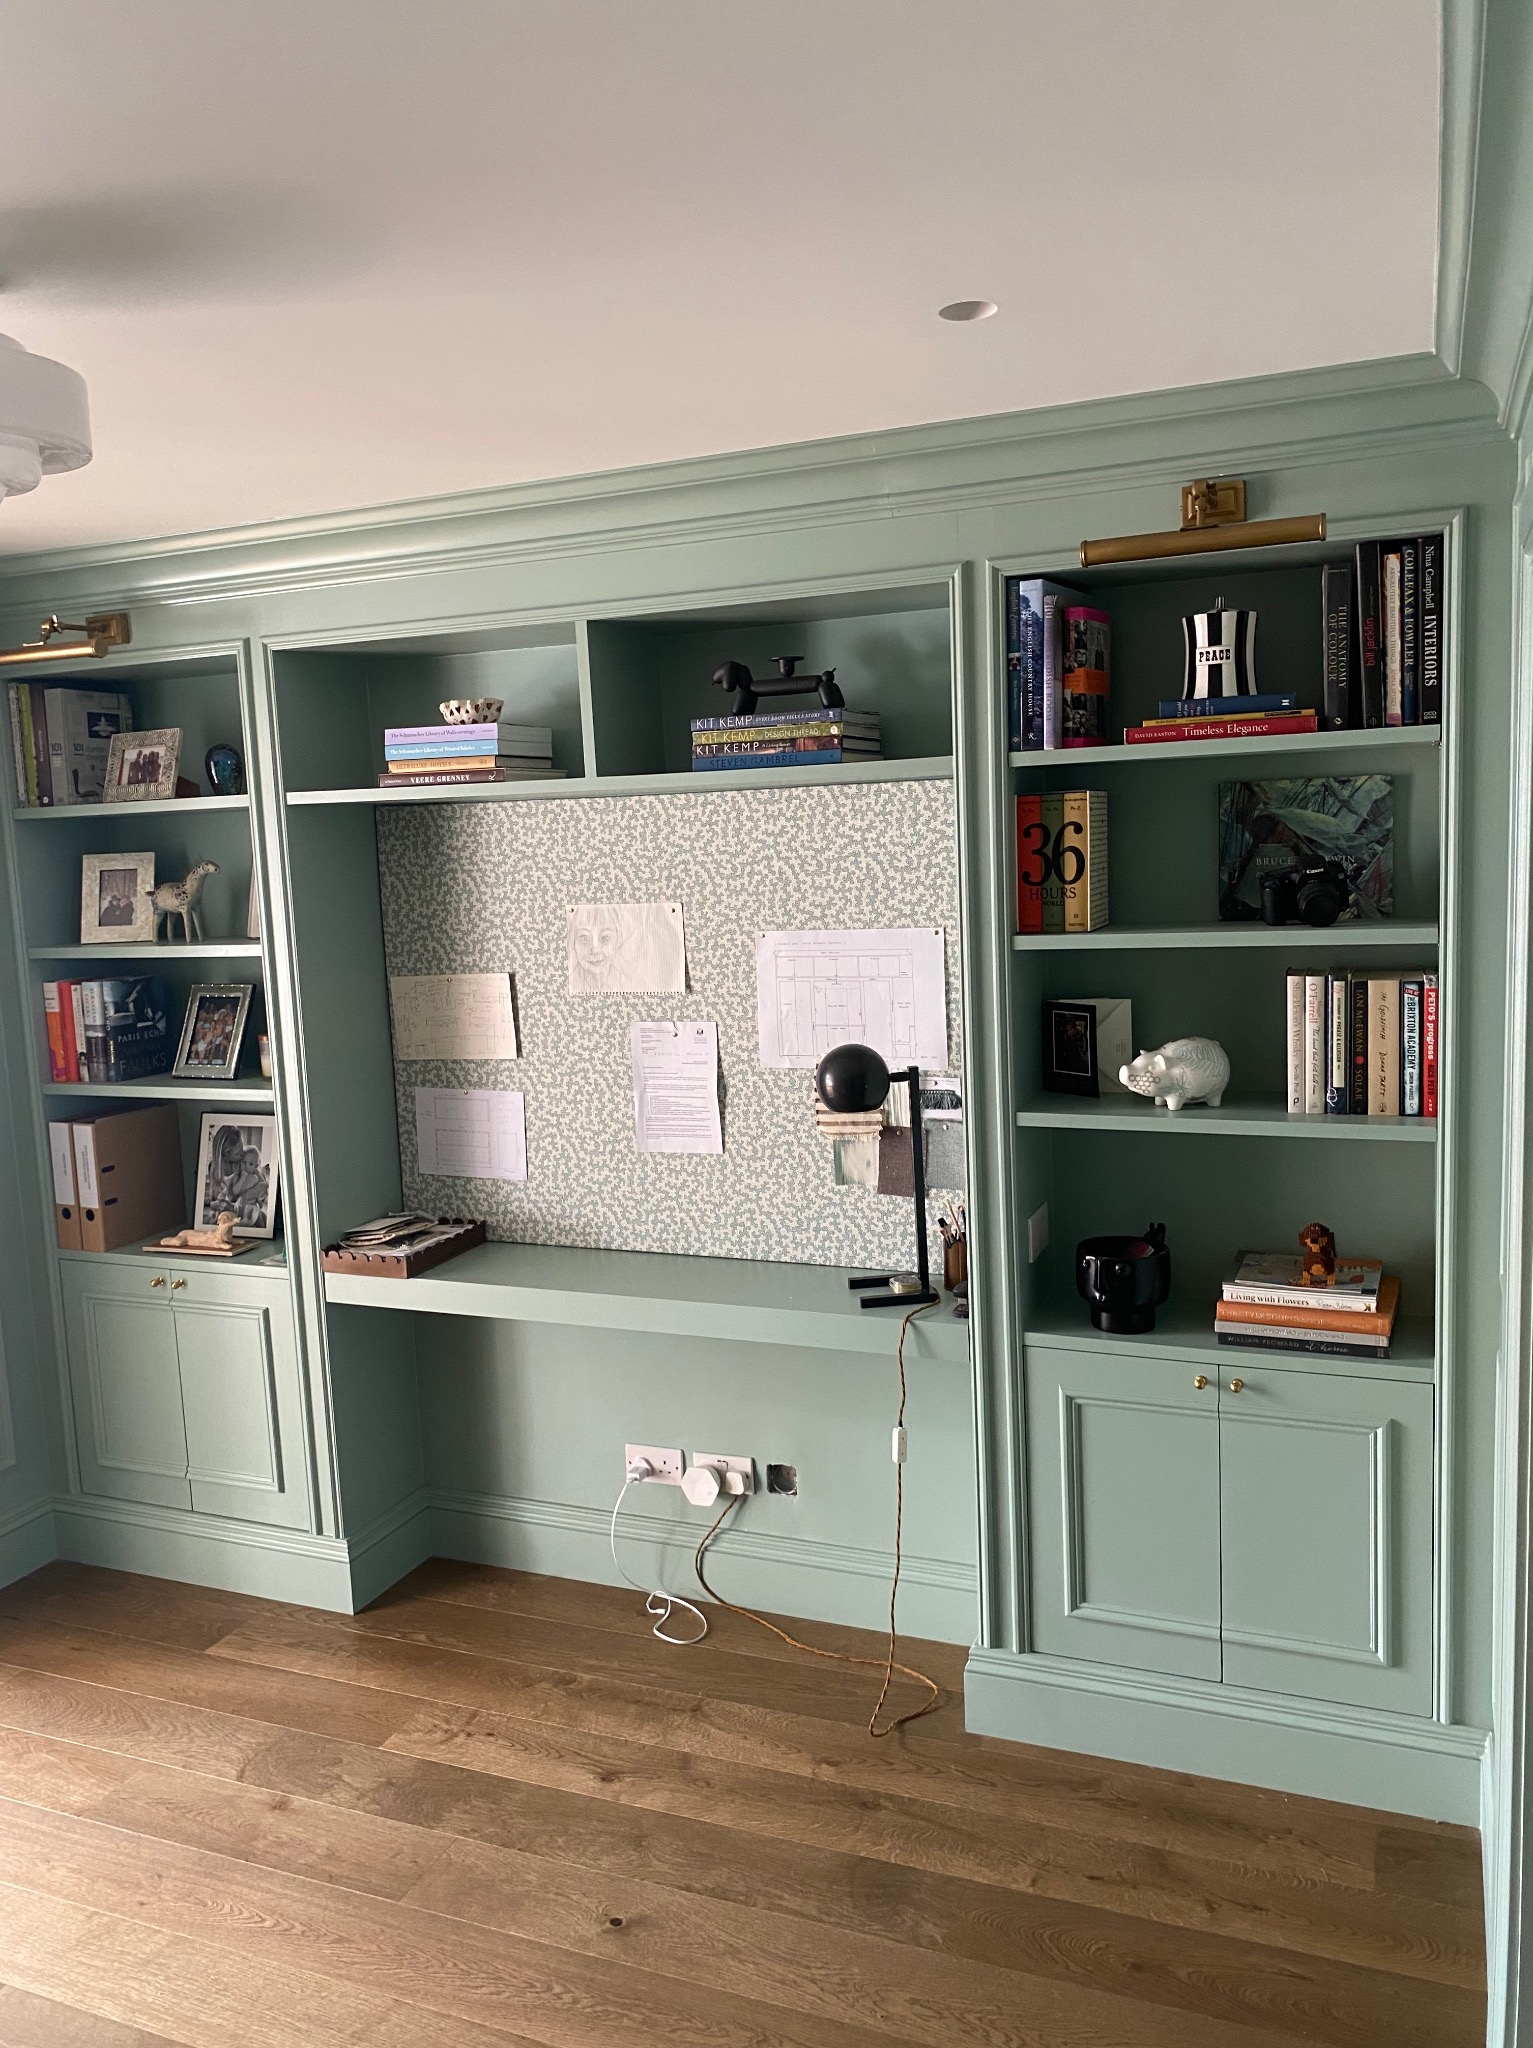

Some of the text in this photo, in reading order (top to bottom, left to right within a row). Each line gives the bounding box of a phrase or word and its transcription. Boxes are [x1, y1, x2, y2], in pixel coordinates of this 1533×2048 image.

[1404, 549, 1414, 609] COLEFAX
[1404, 607, 1413, 615] &
[1423, 546, 1437, 687] Nina Campbell INTERIORS
[1328, 613, 1338, 681] OF COLOUR
[1338, 605, 1348, 688] THE ANATOMY
[1364, 617, 1378, 667] bill jacklin
[1404, 618, 1414, 667] FOWLER
[1198, 648, 1231, 663] PEACE
[696, 717, 715, 729] KIT
[719, 715, 753, 728] KEMP
[1134, 723, 1269, 739] DAVID EASTON Timeless Elegance
[425, 729, 441, 738] Library
[701, 727, 819, 744] KIT KEMP DESIGN THREAD
[51, 742, 62, 751] 101
[73, 742, 84, 751] 101
[696, 744, 719, 755] KIT
[724, 741, 760, 754] KEMP
[430, 761, 452, 769] HOTELS
[709, 754, 800, 769] STEVEN GAMBREL
[410, 775, 434, 785] VEERE
[436, 774, 470, 784] GRENNEY
[1022, 821, 1086, 886] 36
[1256, 857, 1294, 866] BRUCE
[1028, 886, 1077, 901] HOURS
[1292, 981, 1300, 1028] Shackleton's
[1308, 983, 1319, 1024] O'Farrell
[1428, 991, 1436, 1020] PETO'S
[1355, 989, 1364, 1052] IAN McEWAN
[1406, 1002, 1416, 1033] BRIXTON
[117, 1028, 166, 1043] PARIS ECHO
[1292, 1030, 1300, 1059] Whisky
[1426, 1022, 1435, 1060] progress
[1406, 1034, 1416, 1069] ACADEMY
[119, 1052, 167, 1074] FAULKS
[1355, 1069, 1363, 1100] SOLAR
[1230, 1291, 1256, 1304] Living
[1257, 1293, 1276, 1304] with
[1277, 1296, 1310, 1307] Flowers
[1227, 1335, 1259, 1345] WILLIAM
[1262, 1338, 1300, 1349] YEOWARD
[1320, 1342, 1349, 1353] home
